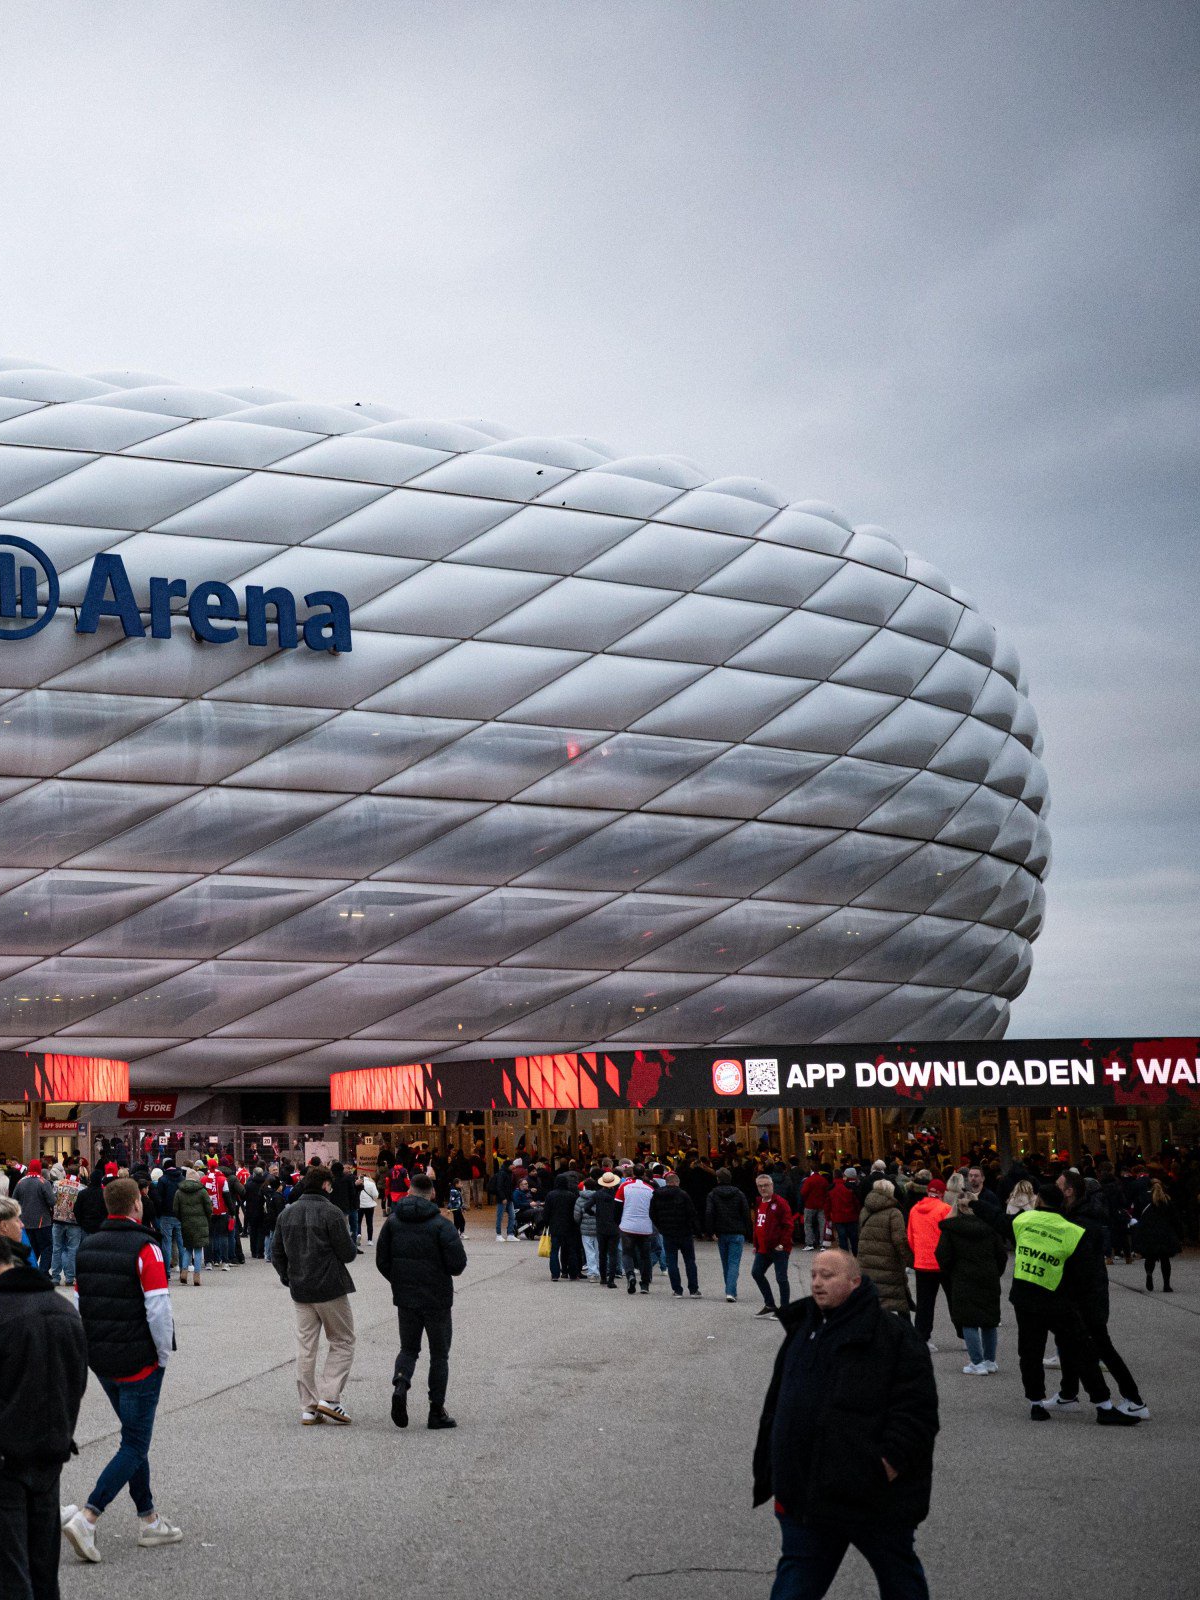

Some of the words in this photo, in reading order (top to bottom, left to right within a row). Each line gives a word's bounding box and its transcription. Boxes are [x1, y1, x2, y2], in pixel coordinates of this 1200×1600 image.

[76, 552, 354, 655] Arena
[786, 1063, 846, 1089] APP
[855, 1058, 1095, 1088] DOWNLOADEN
[1136, 1057, 1200, 1085] WA
[143, 1103, 172, 1112] STORE
